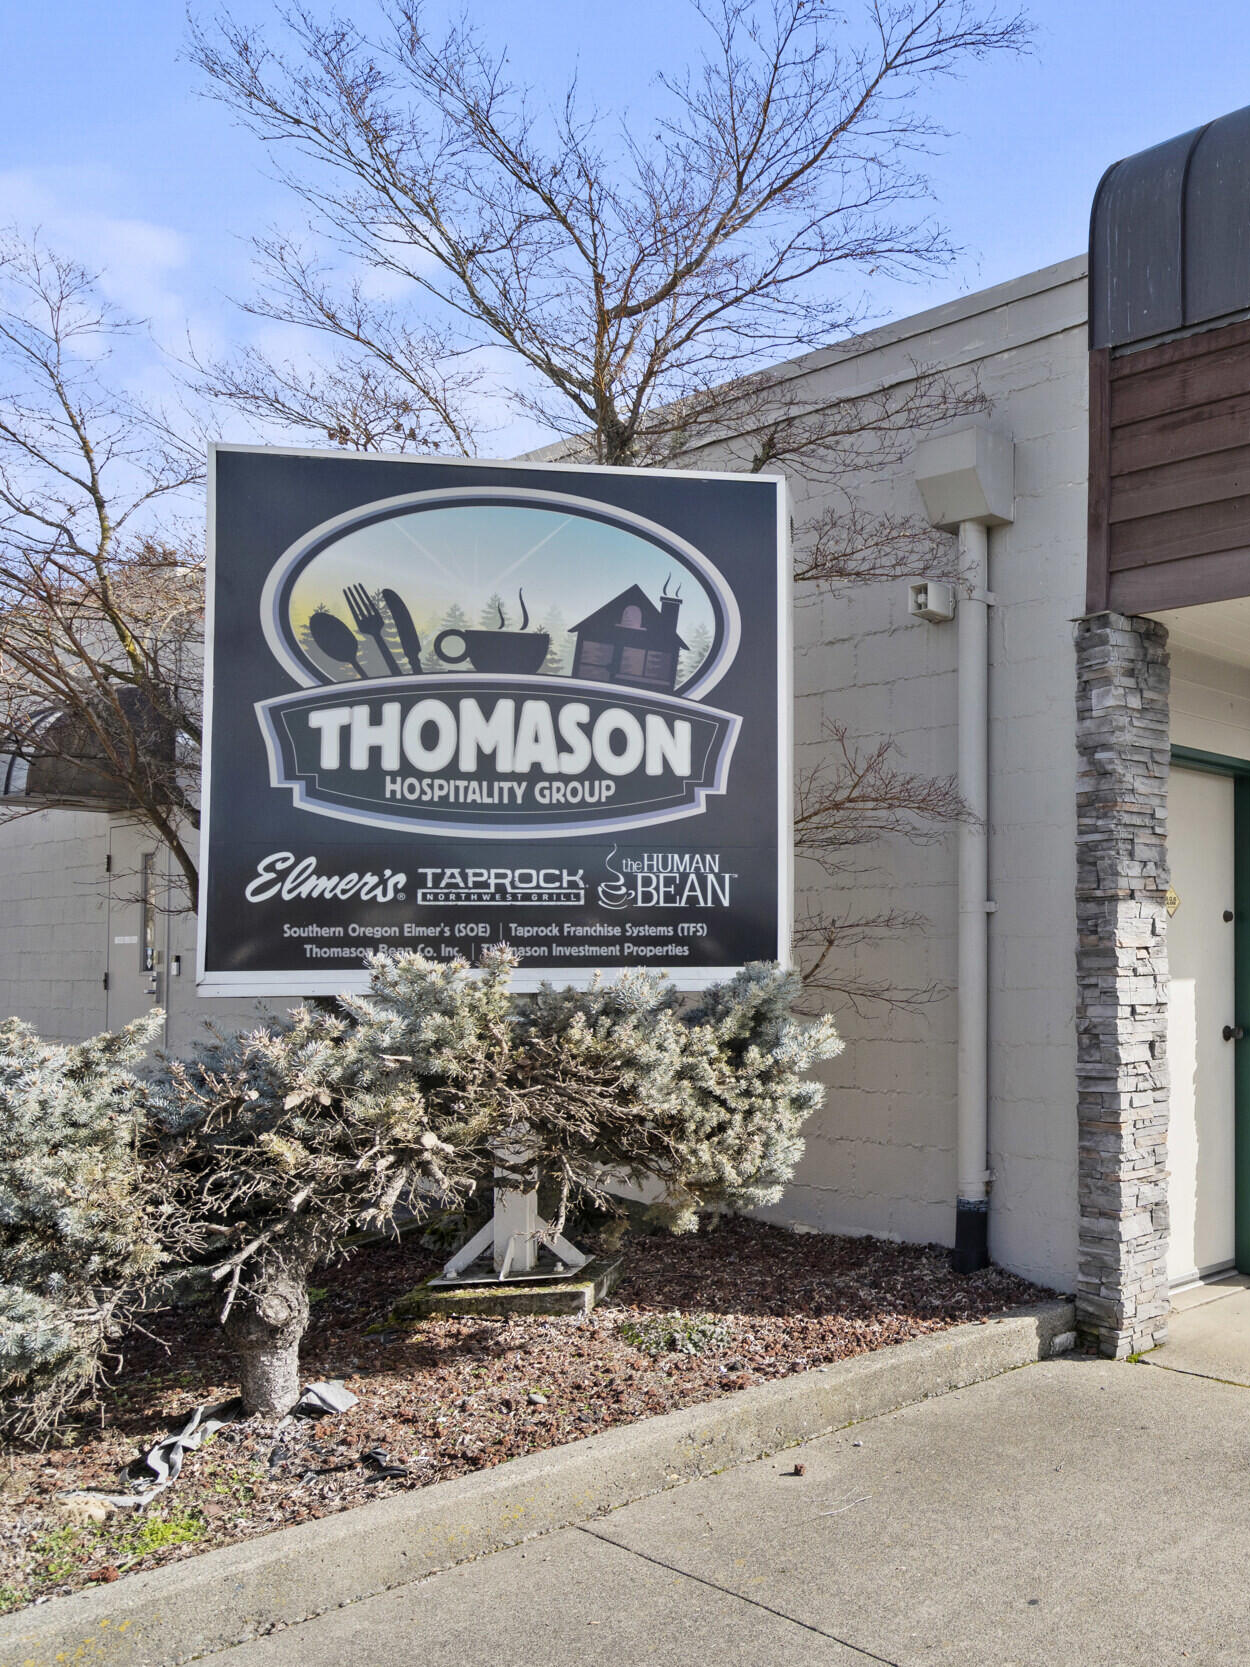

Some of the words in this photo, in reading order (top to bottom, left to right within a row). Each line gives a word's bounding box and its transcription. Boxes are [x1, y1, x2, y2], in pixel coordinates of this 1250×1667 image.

[309, 698, 692, 777] THOMASON
[385, 776, 528, 804] HOSPITALITY
[534, 779, 616, 804] GROUP
[622, 857, 642, 873] the
[643, 853, 720, 873] HUMAN
[245, 851, 407, 903] Elmer's
[417, 868, 584, 891] TAPROCK
[426, 892, 522, 901] NORTHWEST
[531, 892, 577, 901] GRILL
[632, 873, 733, 907] BEAN
[283, 923, 344, 937] Southern
[348, 923, 399, 940] Oregon
[403, 922, 450, 937] Elmer's
[454, 922, 490, 938] (SOE)
[509, 923, 560, 938] Taprock
[563, 922, 622, 936] Franchise
[625, 922, 674, 938] Systems
[677, 922, 708, 938] (TFS)
[417, 943, 437, 958] Co.
[440, 943, 462, 958] Inc.
[552, 943, 621, 957] Investment
[624, 943, 690, 959] Properties
